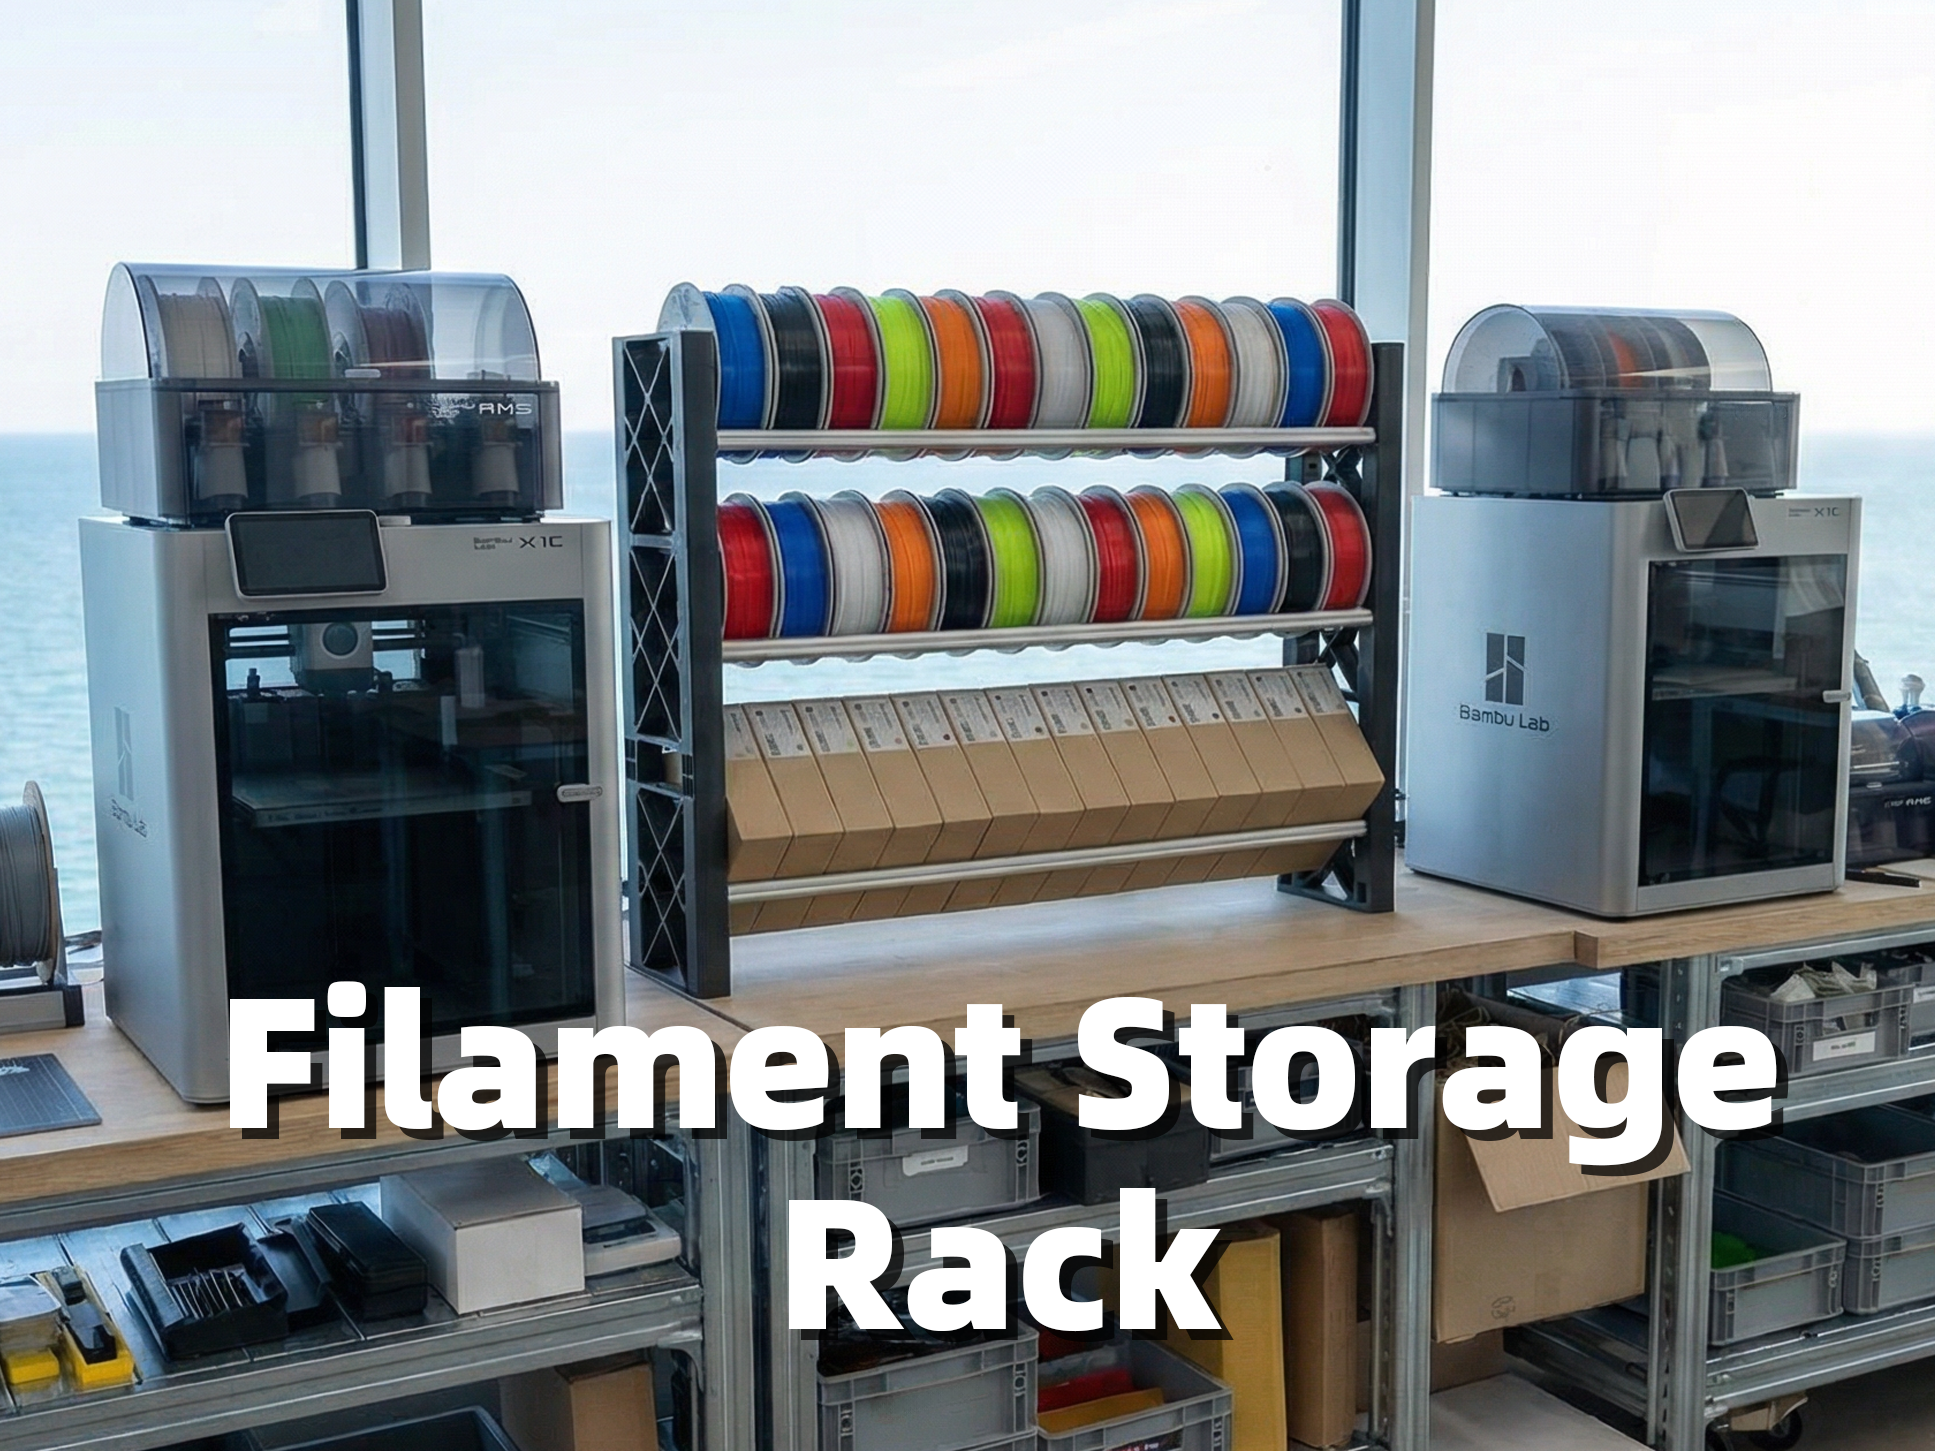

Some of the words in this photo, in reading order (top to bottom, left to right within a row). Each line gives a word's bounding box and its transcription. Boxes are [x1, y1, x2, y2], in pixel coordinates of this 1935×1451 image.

[479, 402, 533, 416] AMS
[1814, 506, 1840, 518] X1C
[519, 535, 563, 549] X1C
[1459, 704, 1515, 728] Bambu
[1519, 713, 1551, 733] Lab
